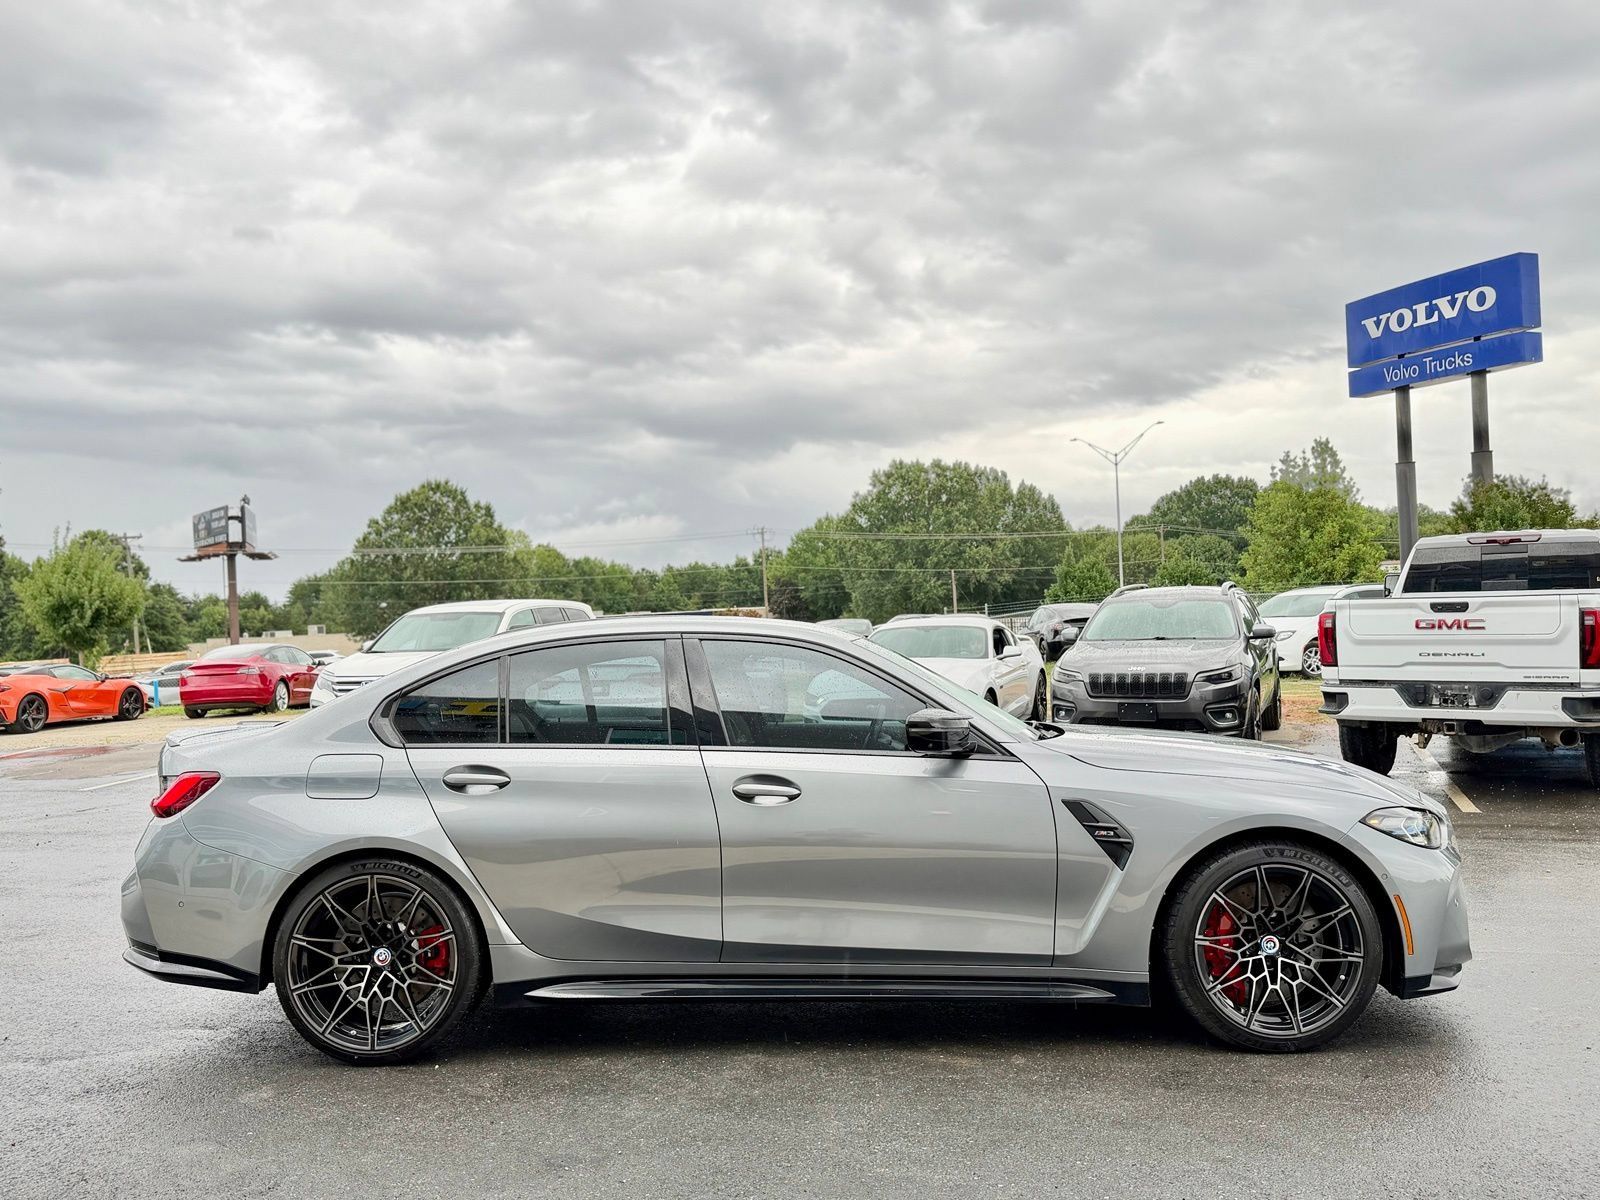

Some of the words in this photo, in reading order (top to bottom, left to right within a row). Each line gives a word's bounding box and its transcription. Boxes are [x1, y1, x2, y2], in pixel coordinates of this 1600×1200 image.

[1361, 285, 1497, 339] VOLVO
[1383, 364, 1419, 383] Volvo
[1422, 350, 1473, 374] Trucks
[1415, 618, 1486, 630] GMC
[365, 863, 420, 878] MICHELIN
[1283, 849, 1350, 884] MICHELIN
